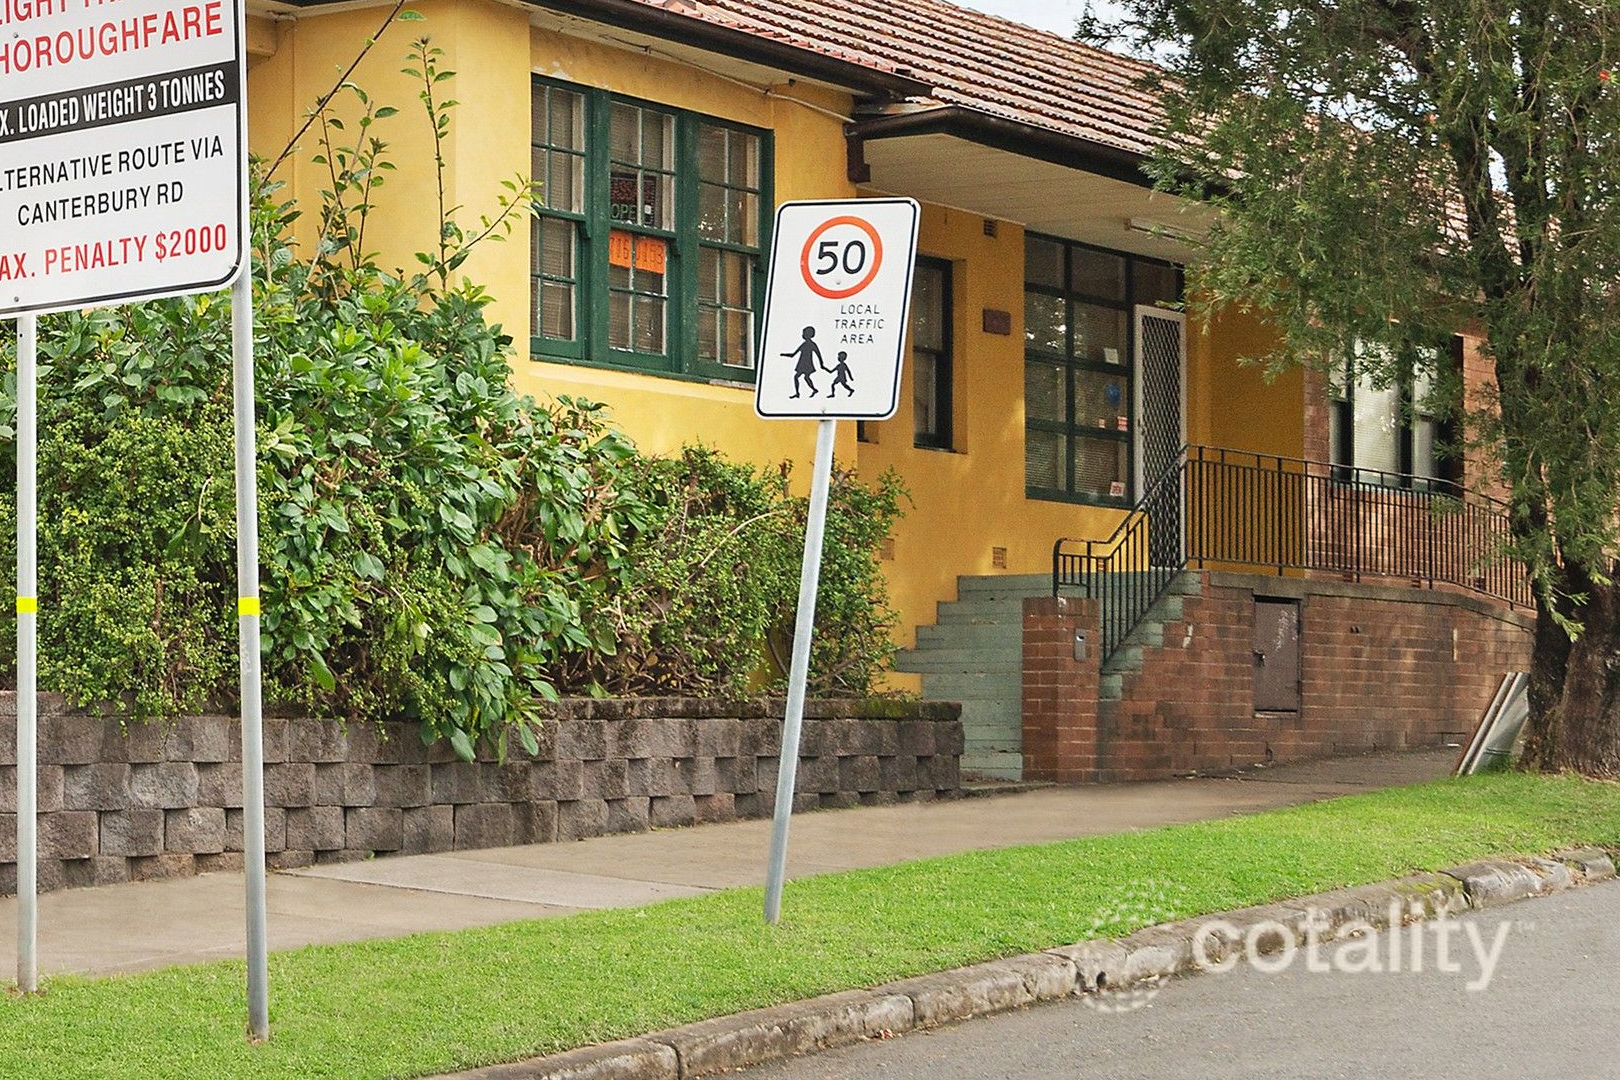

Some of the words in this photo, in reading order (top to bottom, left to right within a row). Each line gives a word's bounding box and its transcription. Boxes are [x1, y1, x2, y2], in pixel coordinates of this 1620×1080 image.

[19, 97, 78, 133] LOADED
[83, 85, 144, 121] WEIGHT
[148, 83, 156, 110] 3
[160, 70, 224, 107] TONNES
[119, 141, 184, 172] ROUTE
[191, 136, 223, 160] VIA
[18, 186, 150, 225] CANTERBURY
[158, 182, 183, 204] RD
[611, 203, 639, 220] OPE
[45, 235, 146, 274] PENALTY
[155, 224, 226, 261] $2000
[816, 240, 866, 275] 50
[835, 319, 884, 329] TRAFFIC
[841, 304, 880, 315] LOCAL
[841, 334, 874, 343] AREA
